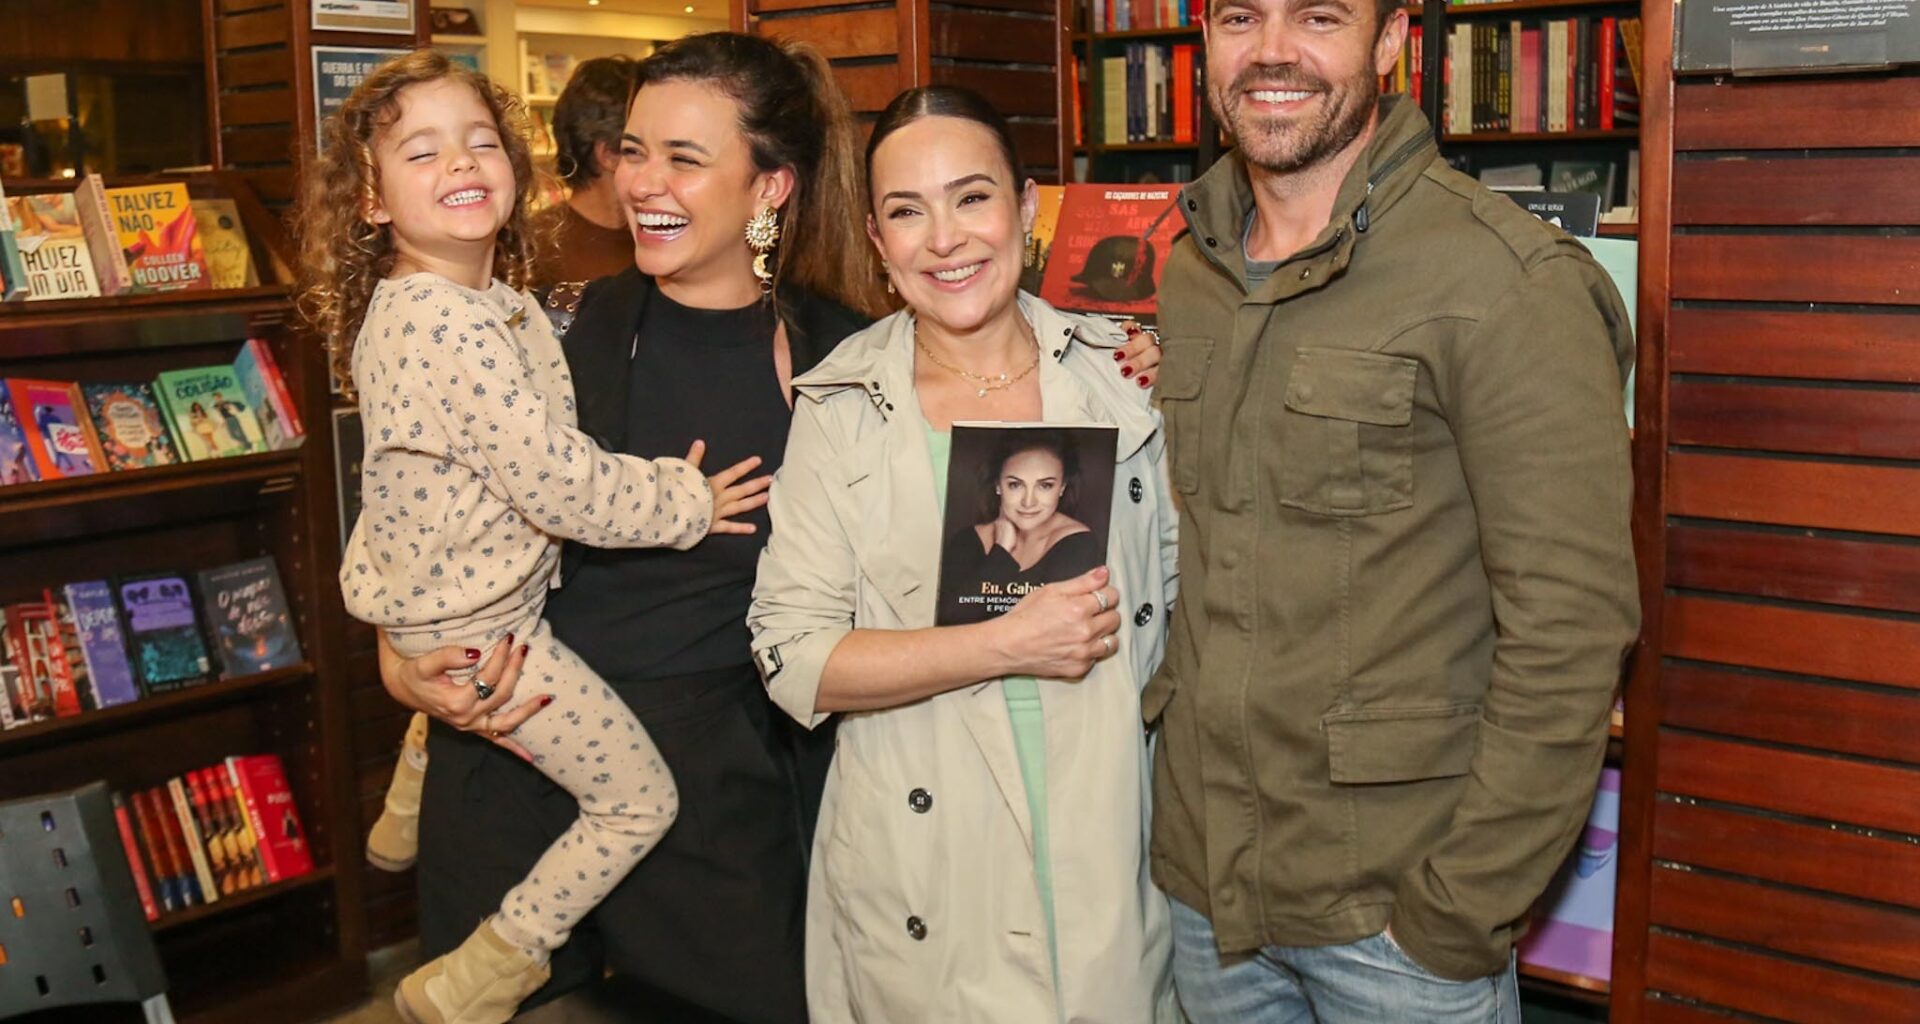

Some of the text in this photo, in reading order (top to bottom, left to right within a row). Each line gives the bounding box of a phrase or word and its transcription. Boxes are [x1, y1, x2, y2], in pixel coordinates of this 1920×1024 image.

[321, 62, 355, 74] GUERRA
[333, 75, 346, 87] DO
[112, 191, 175, 213] TALVEZ
[1109, 203, 1138, 216] SAS
[118, 212, 154, 233] NÃO
[143, 252, 185, 266] COLLEEN
[134, 263, 201, 285] HOOVER
[55, 270, 88, 293] DIA
[958, 596, 985, 604] ENTRE
[986, 604, 1013, 612] E PER
